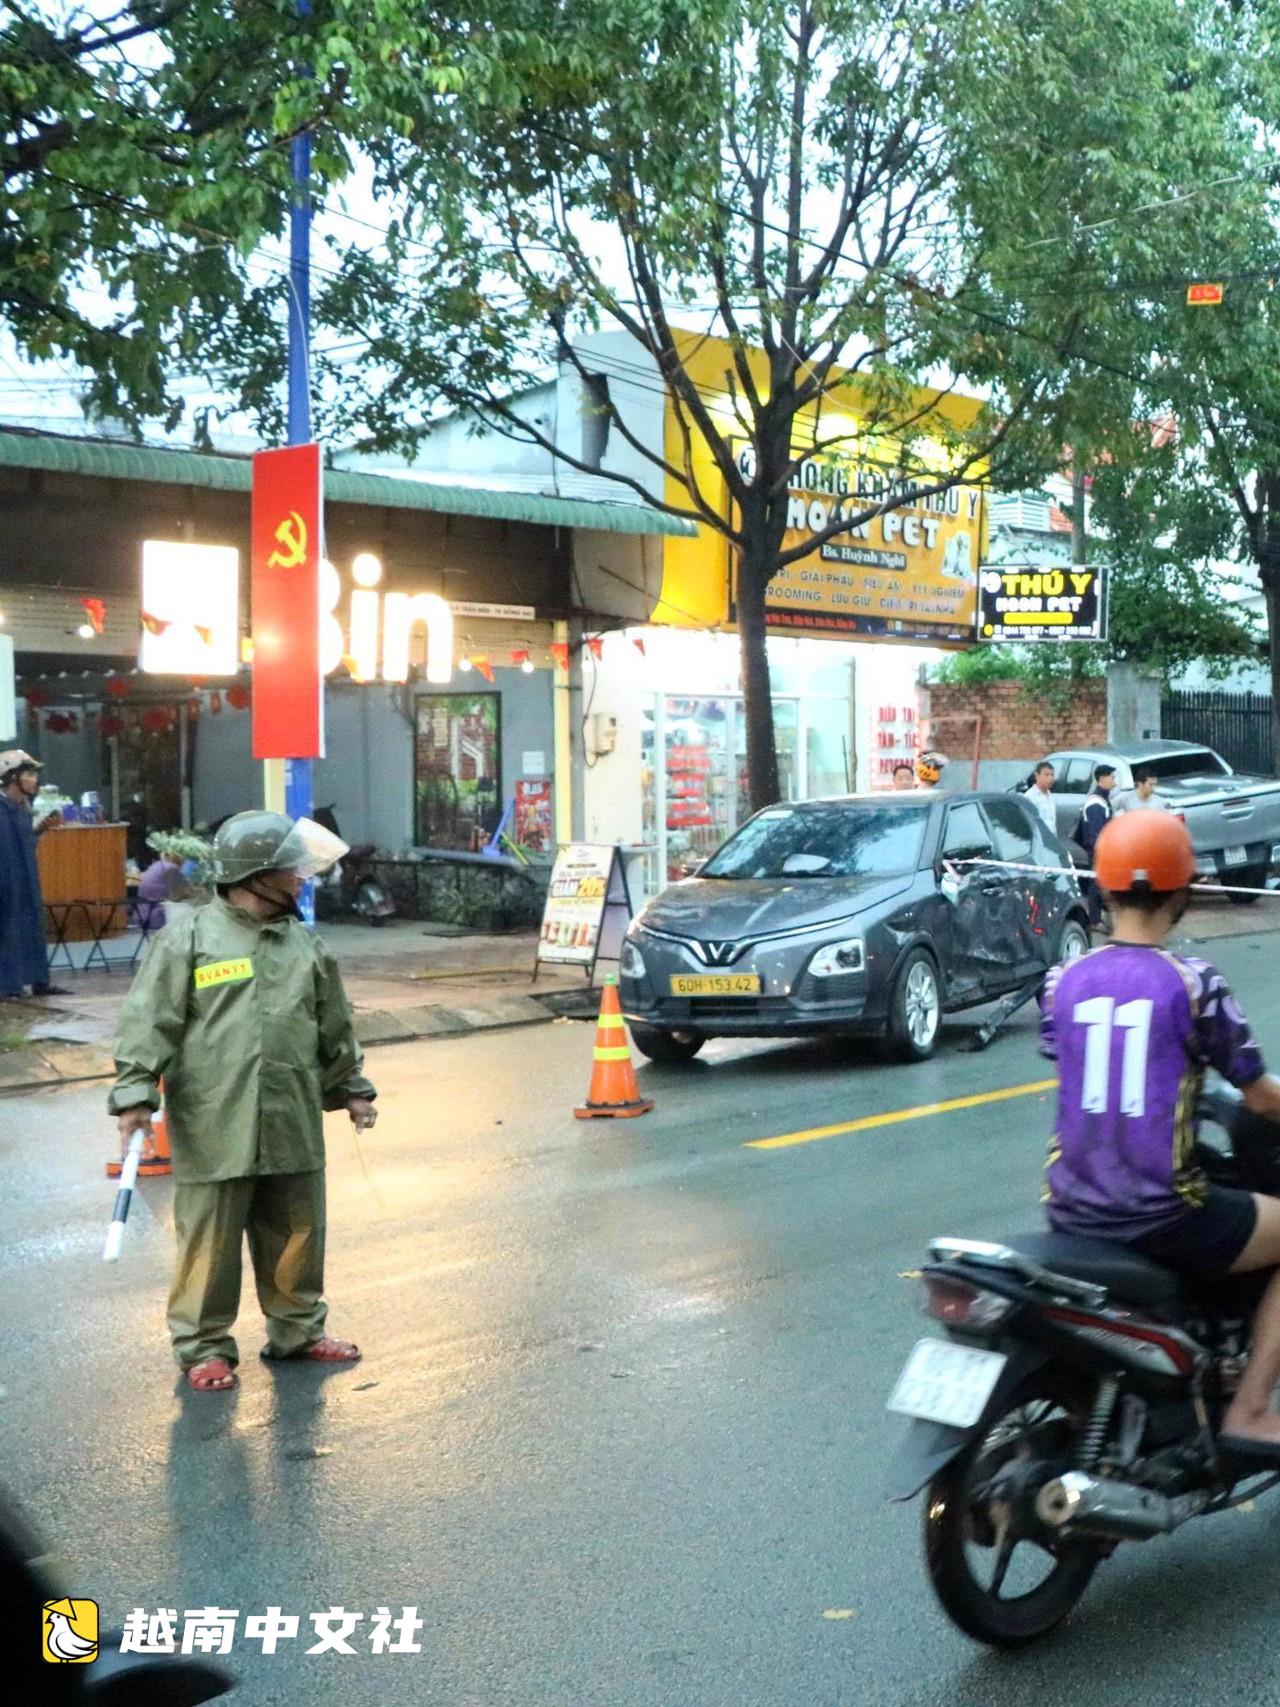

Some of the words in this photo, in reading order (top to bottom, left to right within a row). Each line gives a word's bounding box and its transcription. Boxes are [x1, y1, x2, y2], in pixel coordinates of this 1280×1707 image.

[967, 490, 979, 518] Y
[881, 512, 941, 549] PET
[766, 586, 821, 601] ROOMING
[1001, 570, 1064, 596] THÚ
[1069, 573, 1092, 595] Y
[1073, 996, 1154, 1118] 11
